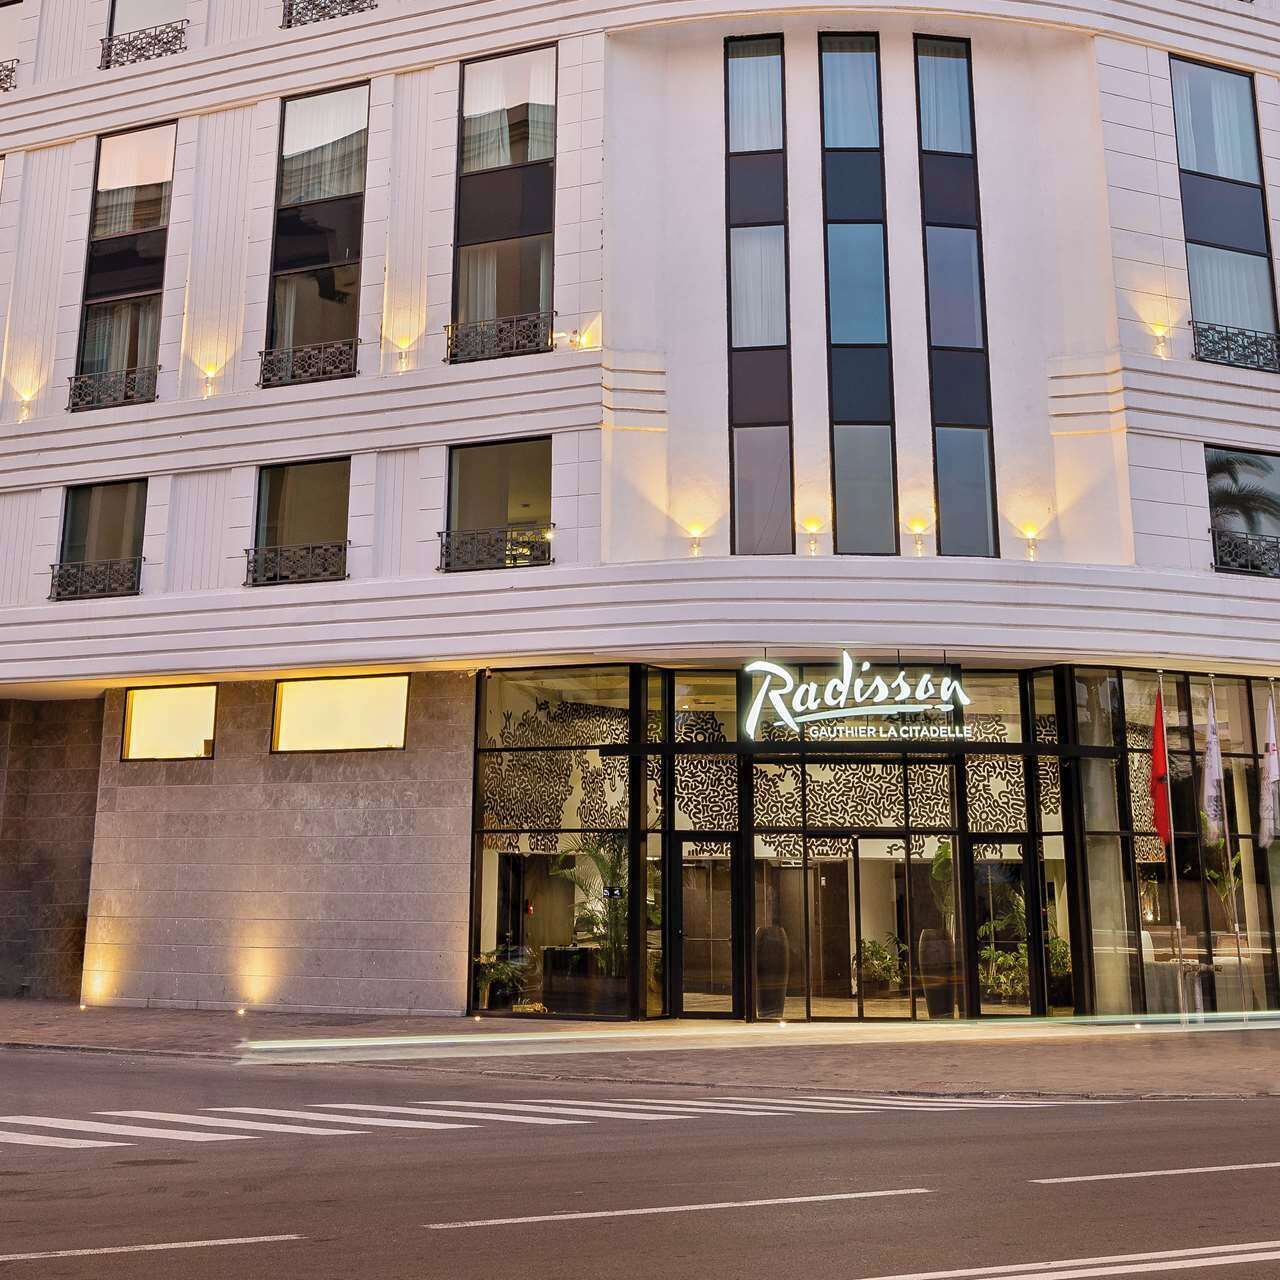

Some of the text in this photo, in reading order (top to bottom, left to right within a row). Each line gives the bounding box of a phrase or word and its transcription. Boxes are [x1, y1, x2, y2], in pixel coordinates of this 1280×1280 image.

[745, 649, 971, 739] Radisson
[809, 726, 972, 738] GAUTHIER LA CITADELLE
